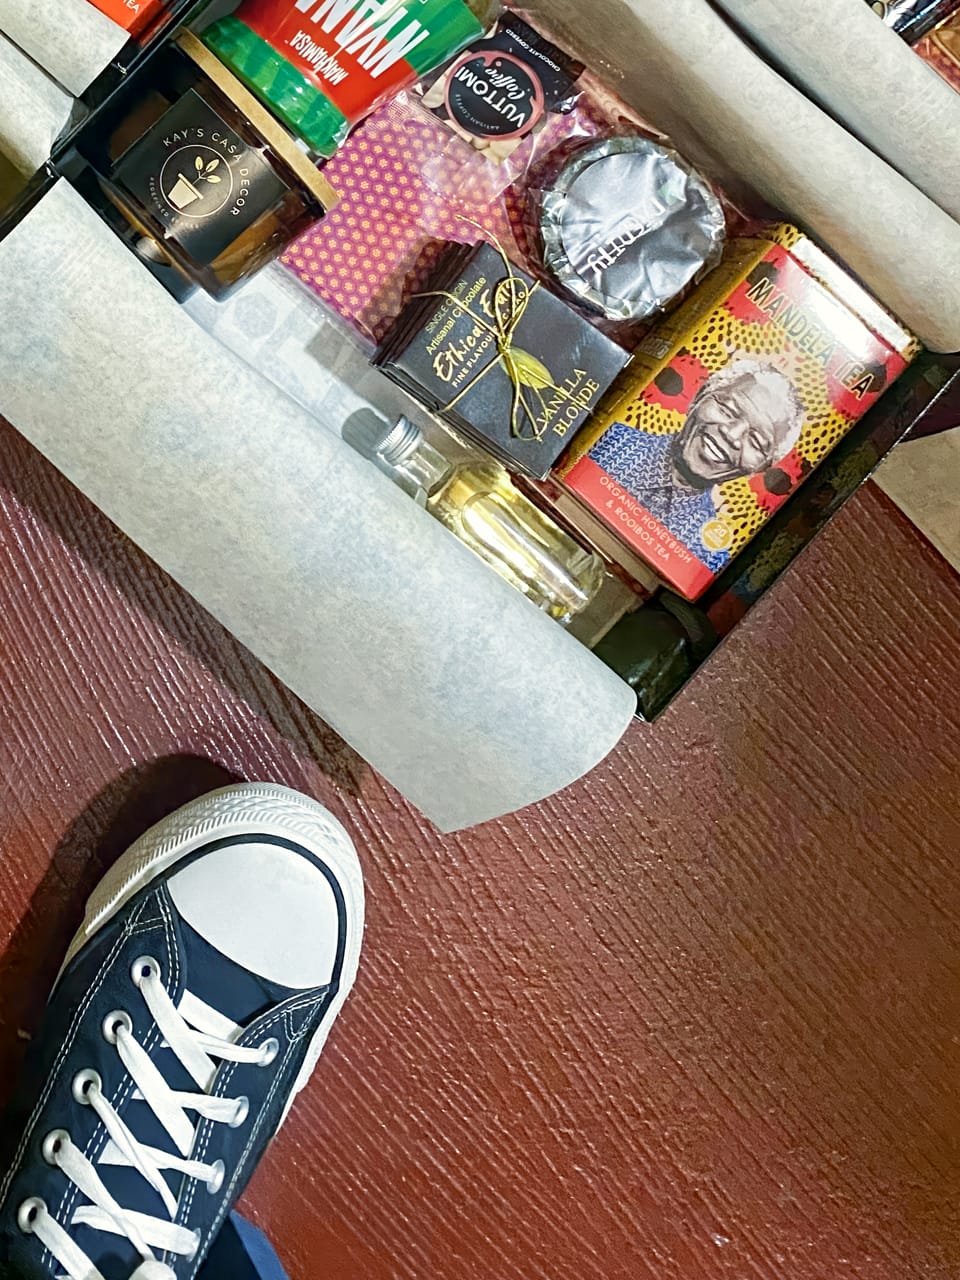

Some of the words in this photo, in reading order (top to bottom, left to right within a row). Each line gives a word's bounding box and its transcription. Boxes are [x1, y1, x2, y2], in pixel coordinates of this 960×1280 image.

[455, 66, 525, 129] VUTTOMI
[485, 67, 525, 102] Coffee
[162, 127, 204, 149] KAY'S
[211, 132, 242, 163] CASA
[229, 167, 251, 216] DECOR
[424, 305, 449, 336] SINGLE
[425, 315, 456, 356] Artisanal
[746, 276, 831, 365] MANDELA
[833, 349, 876, 401] TEA
[451, 366, 472, 388] FINE
[599, 474, 643, 517] ORGANIC
[639, 506, 694, 565] HONEYBUSH
[605, 497, 615, 510] &
[614, 504, 656, 547] ROOIBOS
[655, 542, 671, 562] TEA
